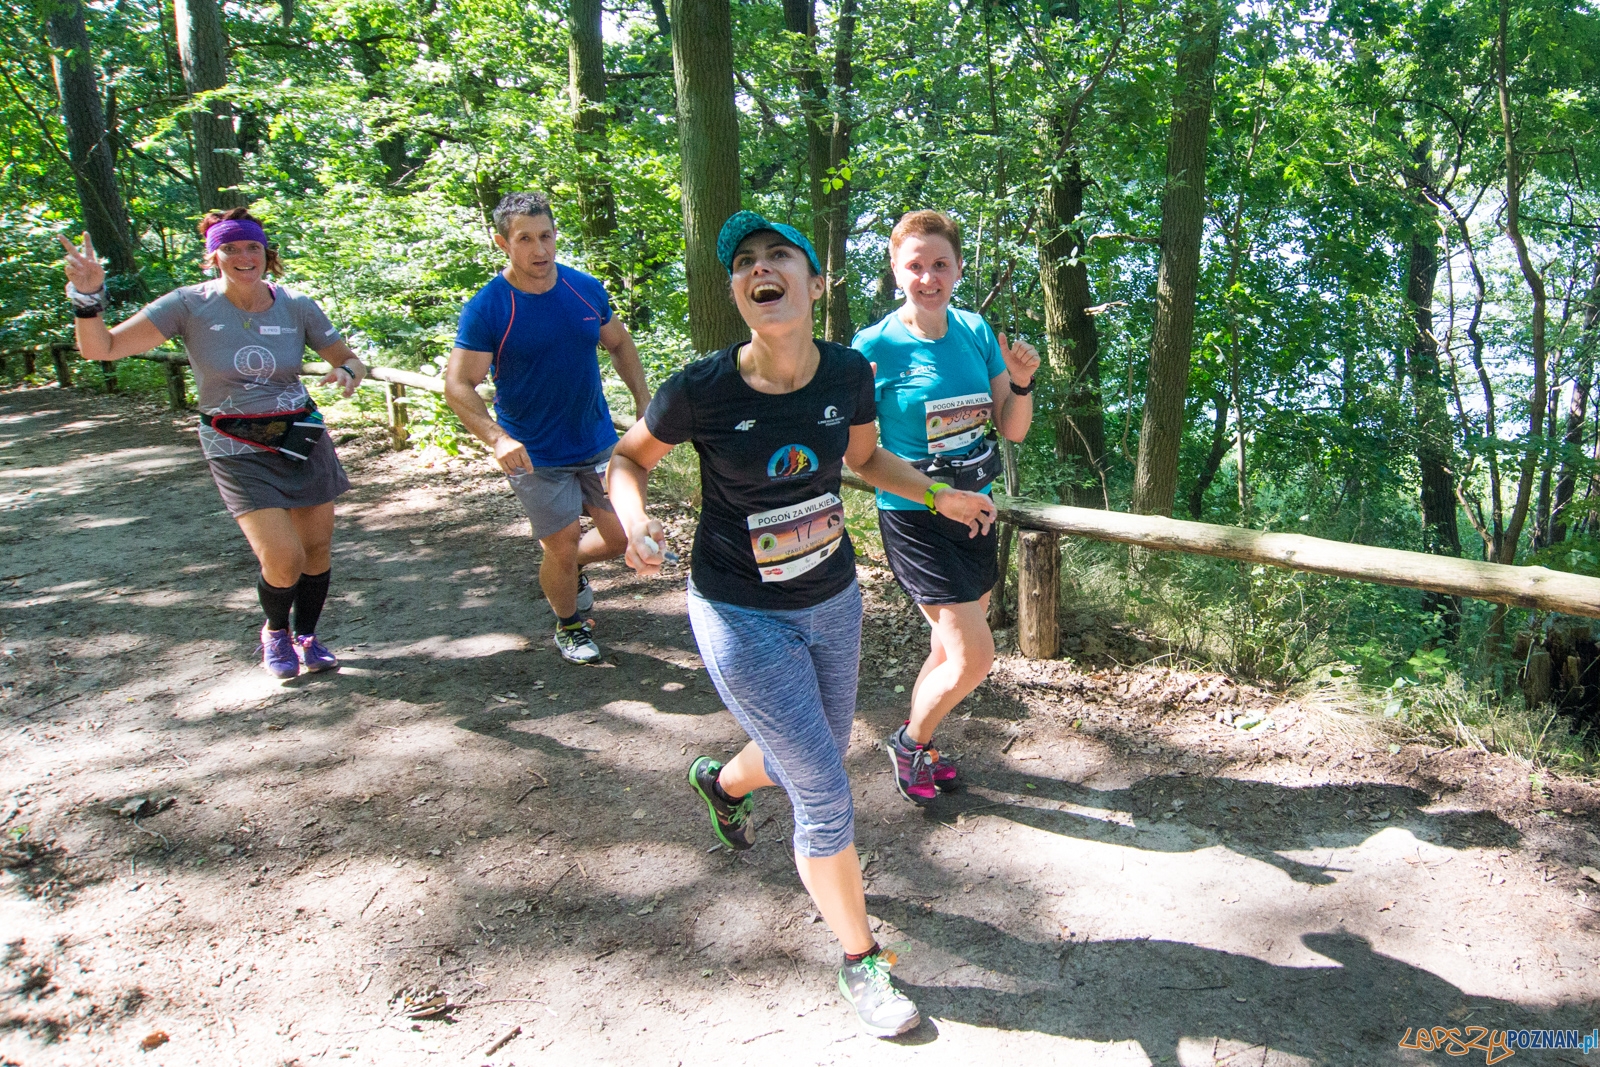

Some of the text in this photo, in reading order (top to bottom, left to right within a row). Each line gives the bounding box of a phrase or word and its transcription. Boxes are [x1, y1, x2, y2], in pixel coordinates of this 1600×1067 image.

[932, 401, 956, 411] POGOŃ
[734, 419, 756, 431] 4F
[757, 497, 837, 526] POGOŃ ZA WILKIEM
[791, 520, 813, 543] 17
[784, 544, 809, 556] IZABELA
